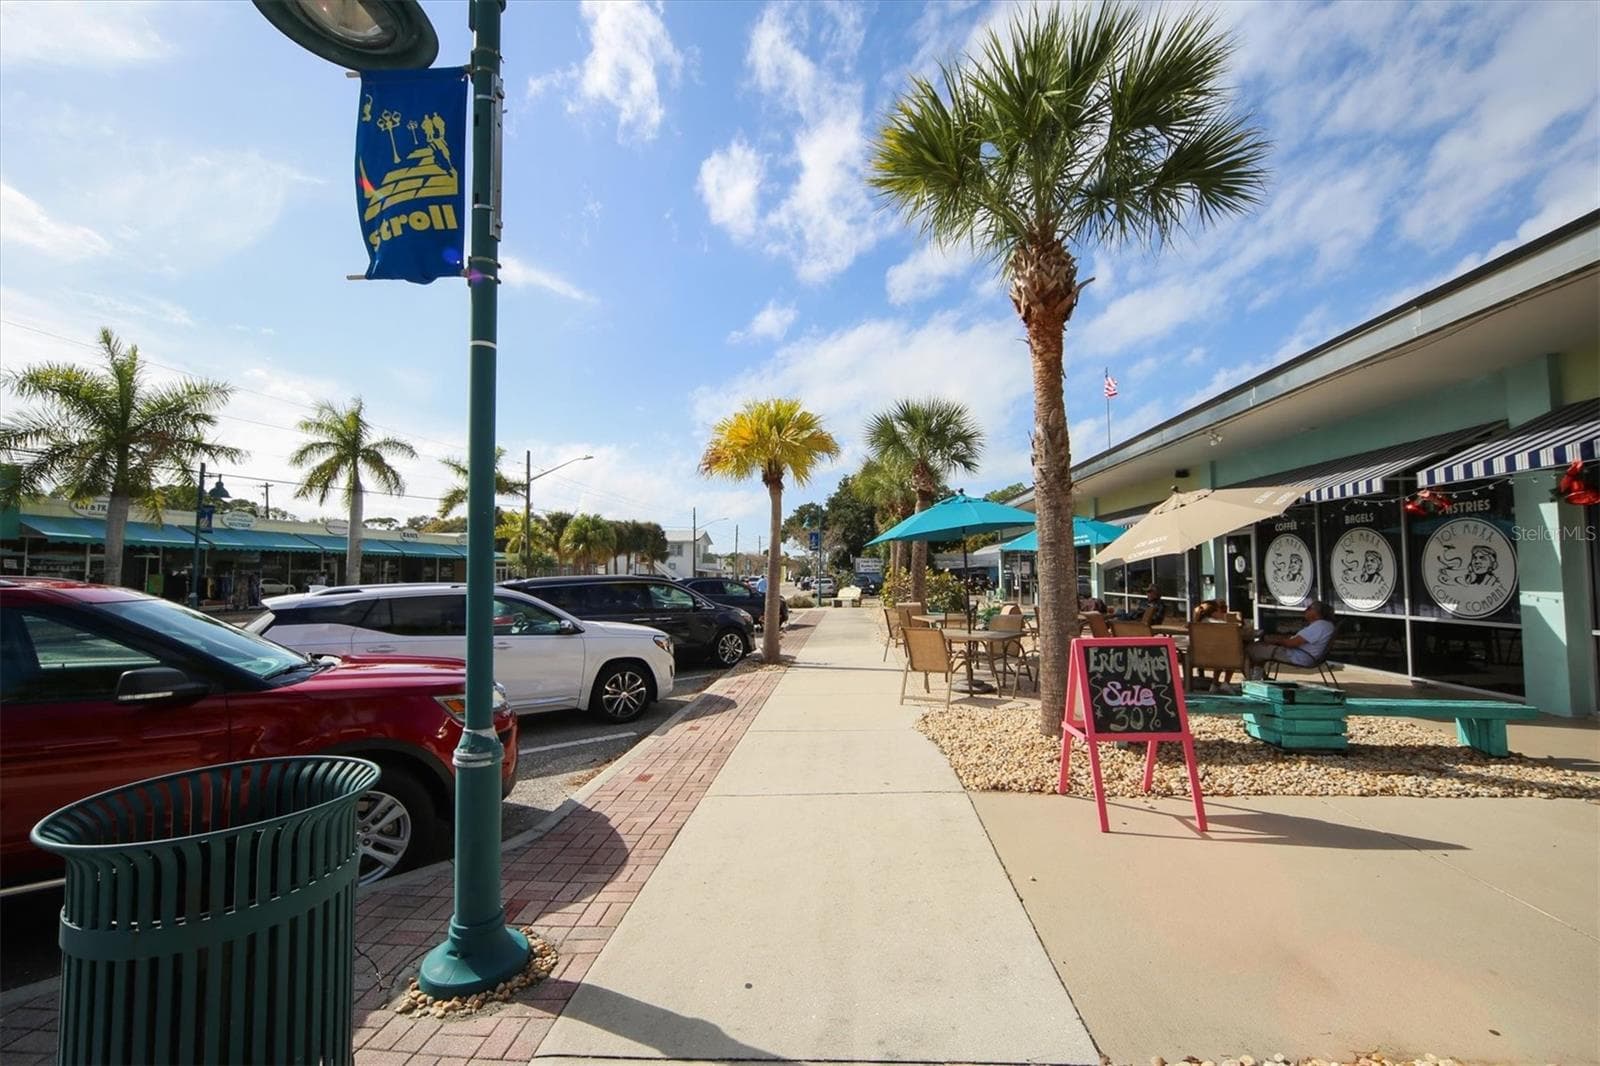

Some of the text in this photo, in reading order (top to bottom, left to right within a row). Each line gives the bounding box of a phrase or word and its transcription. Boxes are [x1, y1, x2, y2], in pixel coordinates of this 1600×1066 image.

[369, 205, 458, 251] stroll
[1439, 499, 1491, 515] ASTRIES
[1274, 520, 1298, 532] COFFEE
[1344, 512, 1375, 525] BAGELS
[1435, 527, 1457, 545] JOE
[1465, 583, 1508, 612] COMPANY
[1102, 681, 1156, 707] Sale
[1109, 706, 1162, 731] 30%
